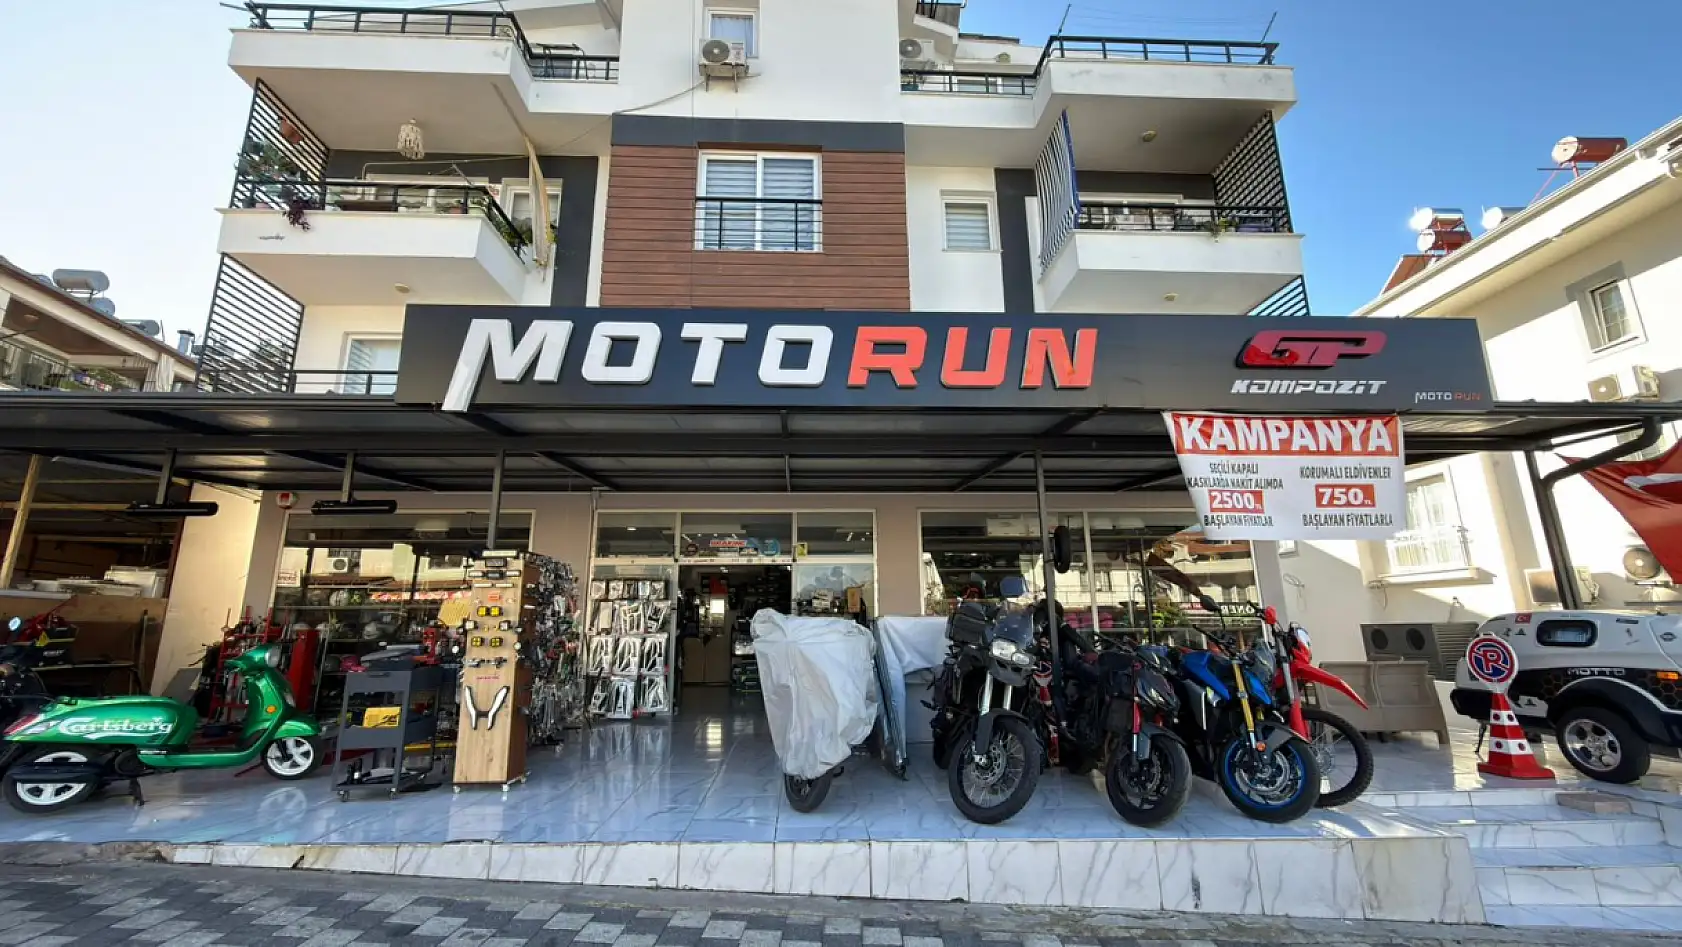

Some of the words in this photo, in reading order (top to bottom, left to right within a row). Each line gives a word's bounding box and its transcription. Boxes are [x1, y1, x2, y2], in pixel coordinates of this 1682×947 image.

[1238, 329, 1387, 368] GP
[442, 318, 1099, 412] MOTORUN
[1181, 418, 1392, 452] KAMPANYA
[1299, 465, 1343, 479] KORUMALI
[1254, 477, 1284, 491] ALIMDA
[1204, 514, 1243, 529] BAŞLAYAN
[1302, 514, 1345, 529] BAŞLAYAN
[1567, 667, 1626, 676] MOTTO
[59, 716, 173, 740] Carlsberg
